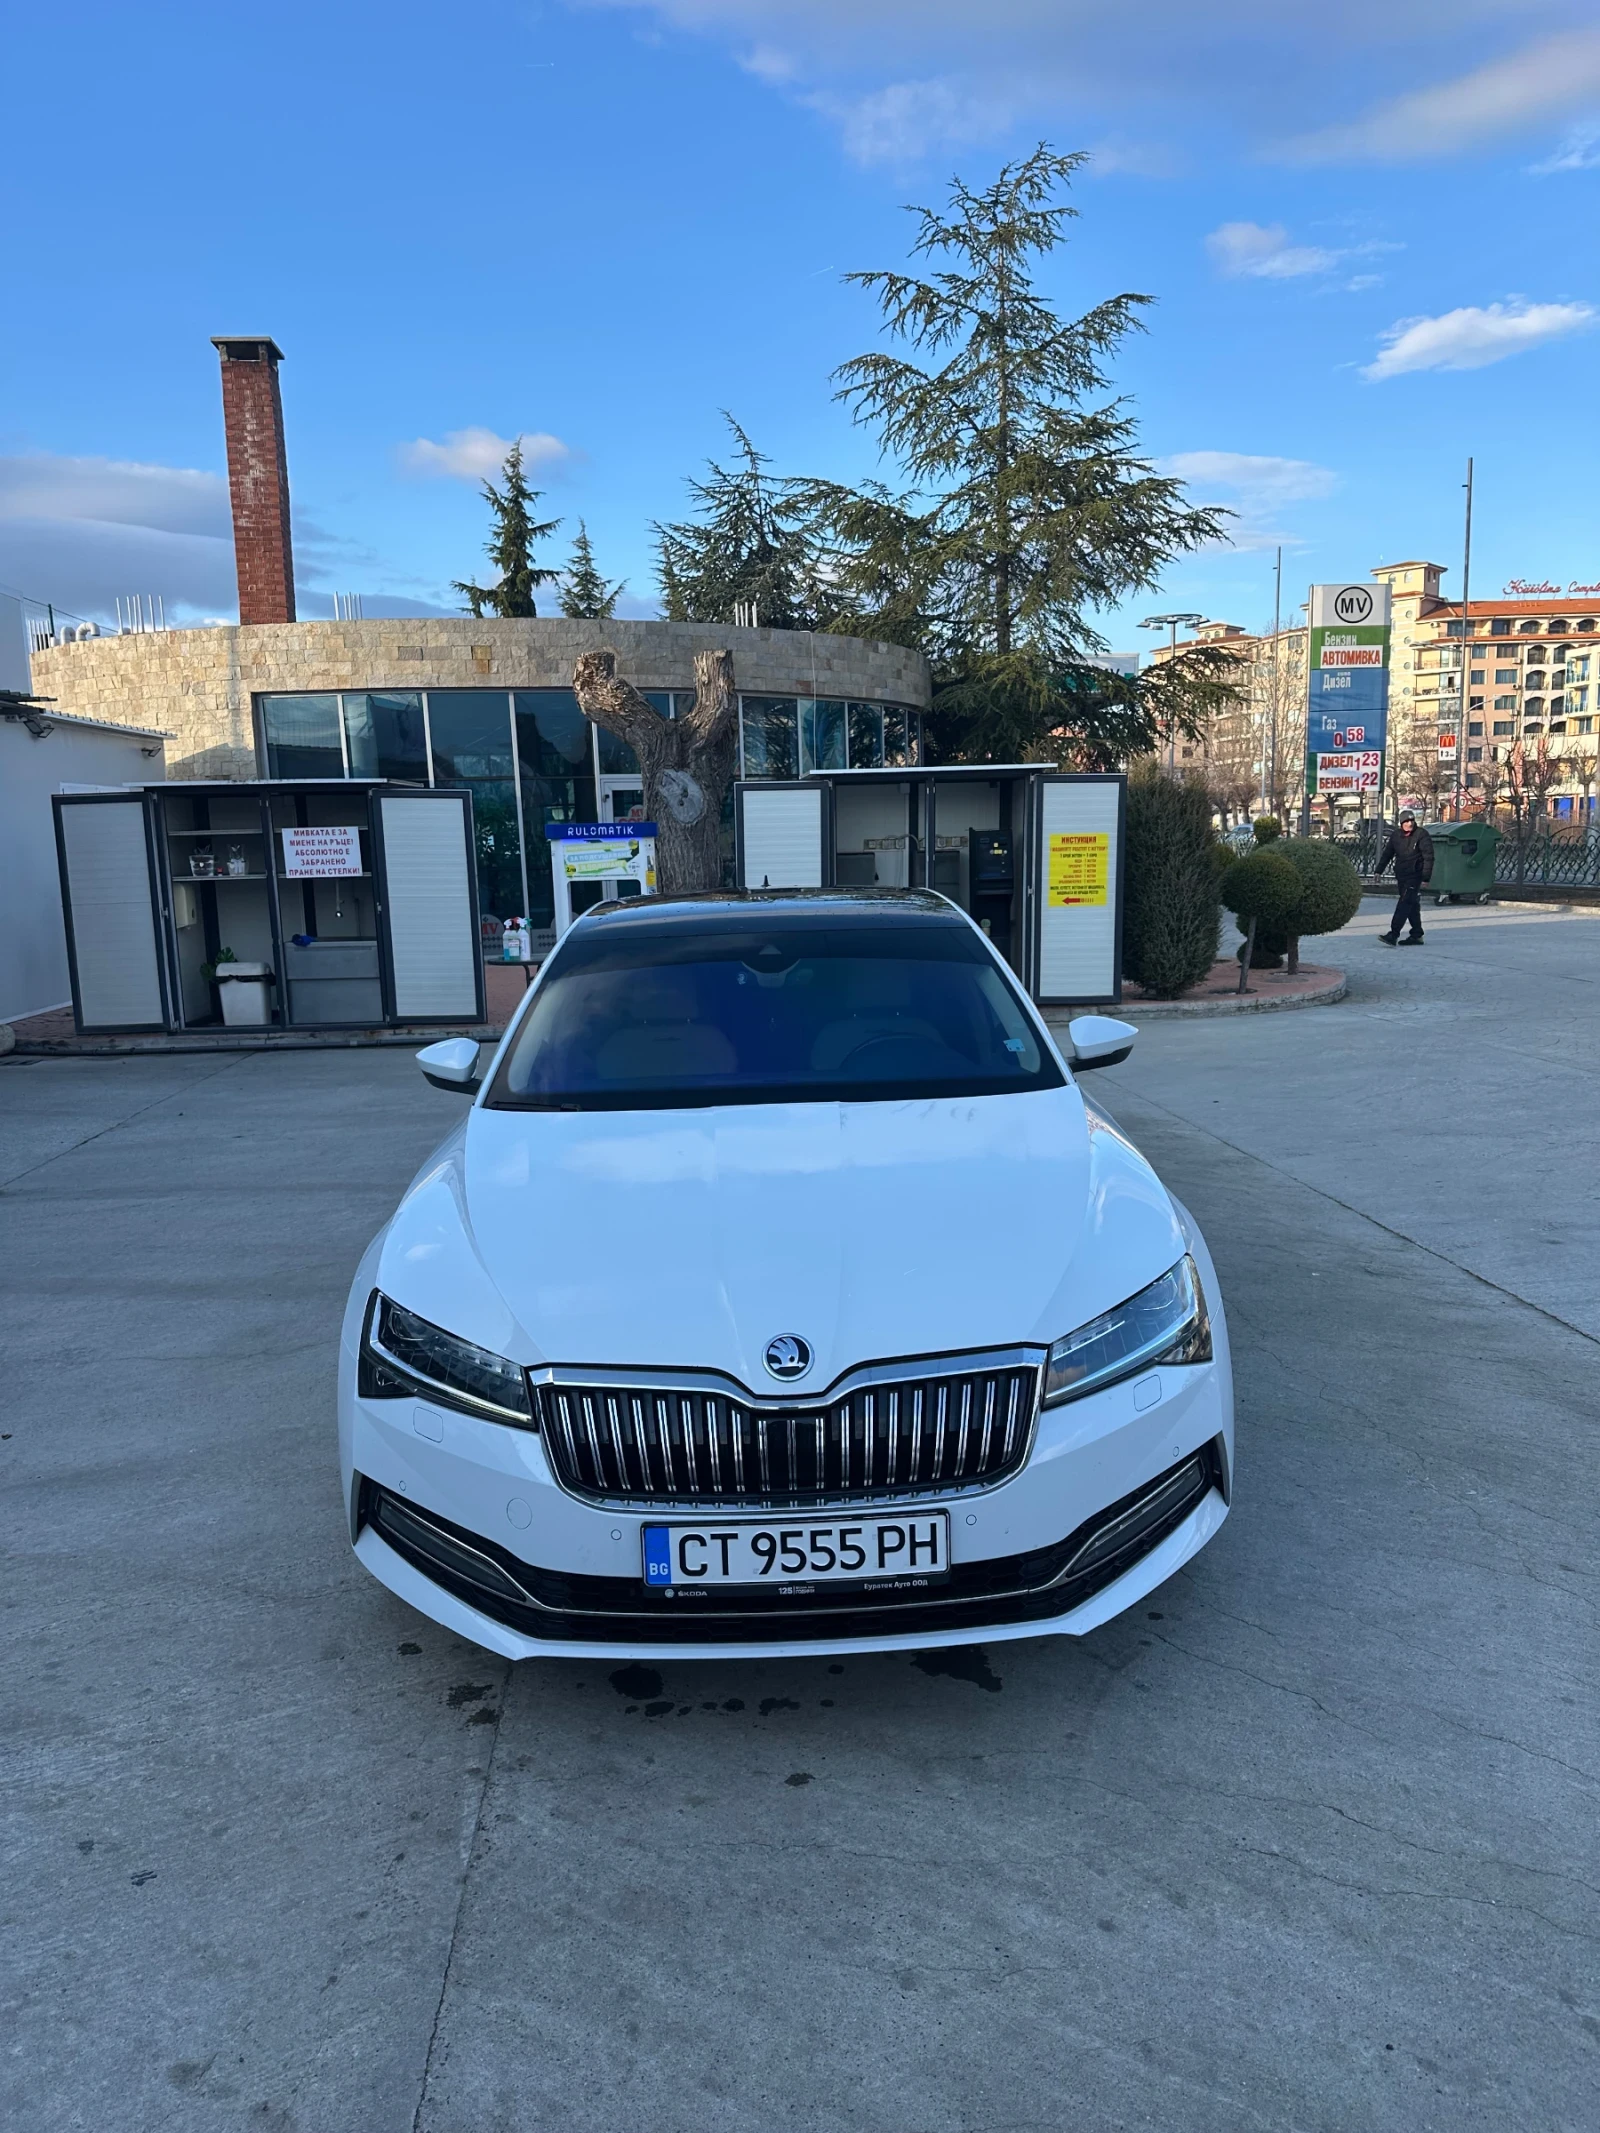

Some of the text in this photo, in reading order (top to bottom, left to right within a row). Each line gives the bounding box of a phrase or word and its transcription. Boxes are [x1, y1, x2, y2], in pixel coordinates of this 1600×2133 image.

[1341, 597, 1367, 614] MV
[1324, 631, 1357, 646] Бензин
[1322, 649, 1381, 666] АВТОМИВКА
[1323, 674, 1351, 692] Дизел
[1322, 716, 1337, 731] Газ
[1320, 755, 1353, 771] ДИЗЕЛ
[1319, 776, 1353, 790] БЕНЗИН
[294, 828, 348, 837] МИВКАТА Е ЗА
[568, 825, 634, 836] RULOMATIK
[289, 839, 316, 847] МИЕНЕ
[330, 838, 354, 847] РЪЦЕ!
[295, 848, 344, 857] АБСОЛЮТНО
[300, 858, 346, 866] ЗАБРАНЕНО
[327, 867, 360, 875] СТЕЛКИ!
[678, 1522, 938, 1577] CT 9555 PH
[650, 1563, 669, 1576] BG
[778, 1586, 793, 1595] 125
